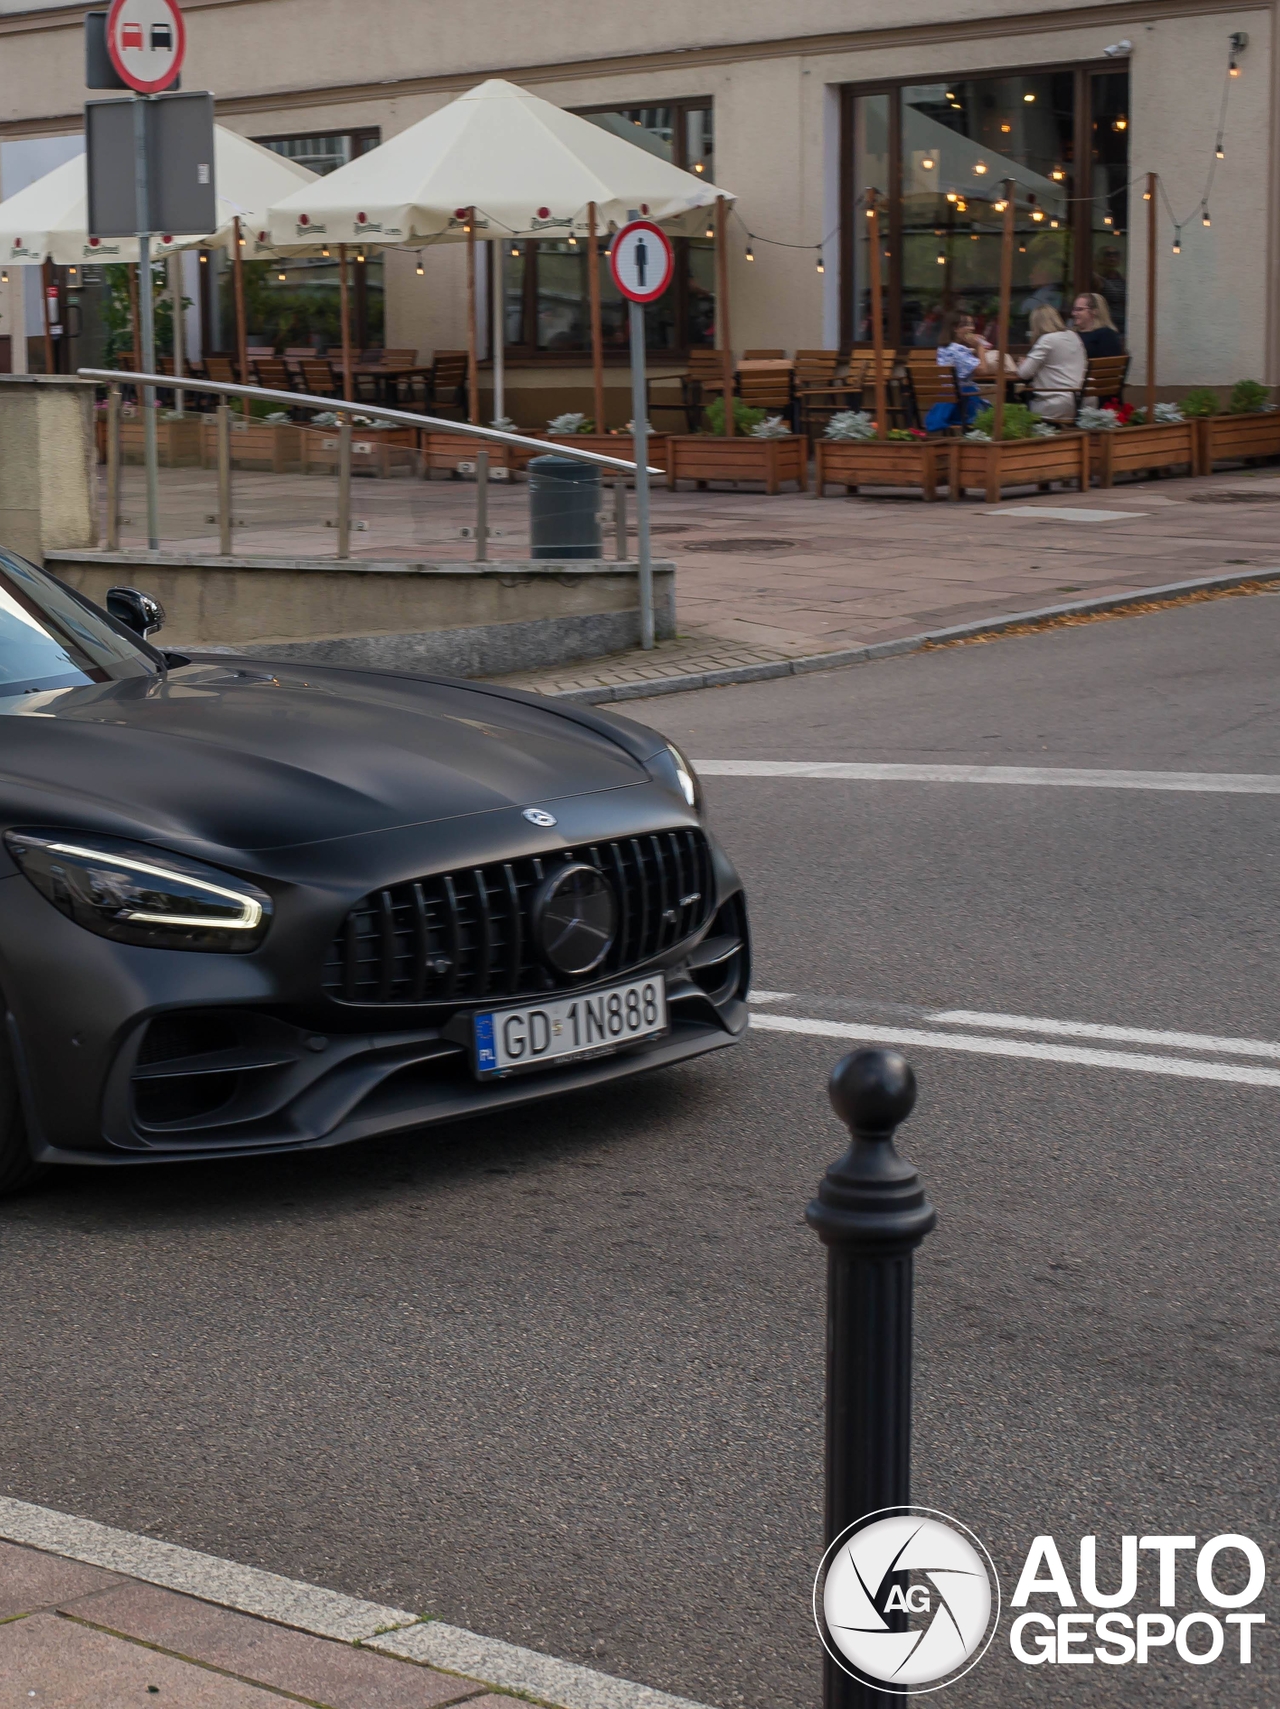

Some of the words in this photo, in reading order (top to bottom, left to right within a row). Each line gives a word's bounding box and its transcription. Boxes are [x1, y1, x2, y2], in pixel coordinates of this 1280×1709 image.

[503, 1009, 551, 1059] GD
[566, 983, 657, 1046] 1N888
[479, 1048, 496, 1062] PL
